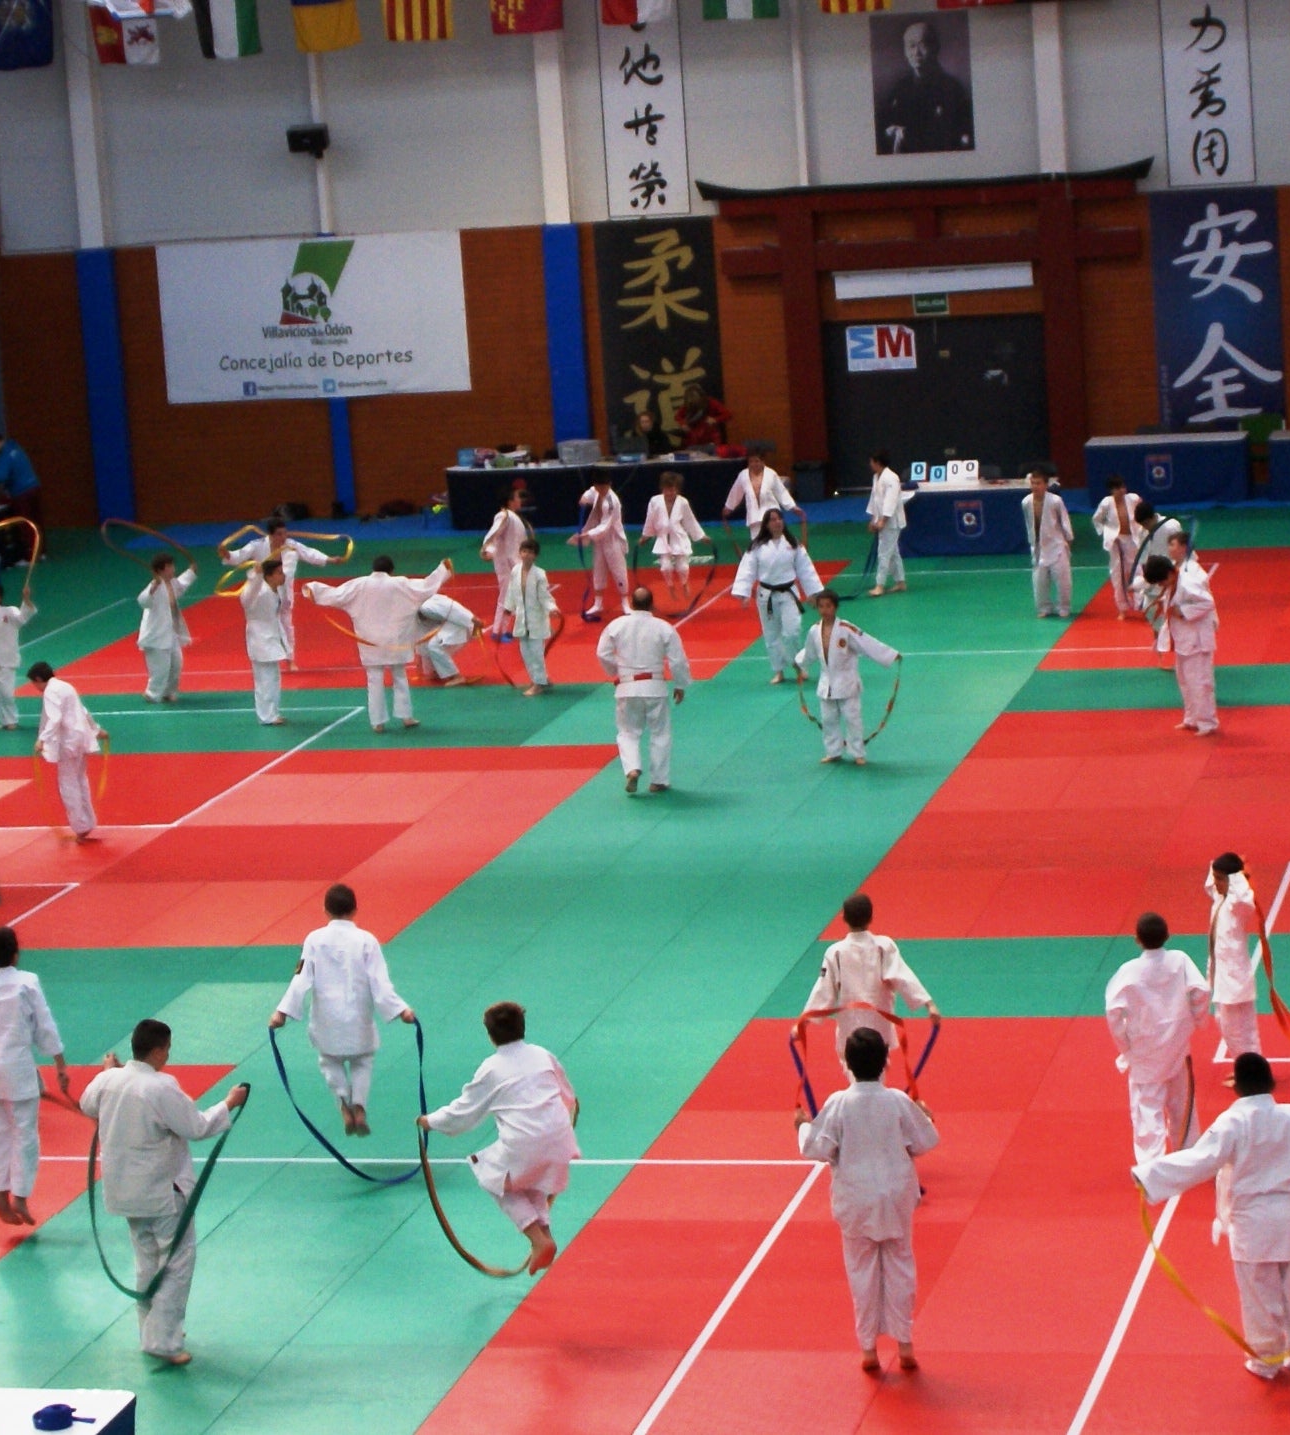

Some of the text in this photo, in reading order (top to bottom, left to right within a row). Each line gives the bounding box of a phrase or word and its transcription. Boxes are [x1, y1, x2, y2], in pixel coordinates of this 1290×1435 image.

[1172, 202, 1284, 424] 安全
[262, 325, 317, 339] Villaviciosa
[324, 323, 353, 337] Odón
[219, 350, 413, 374] Concejalía de Deportes
[914, 461, 975, 479] 0 0 0 0
